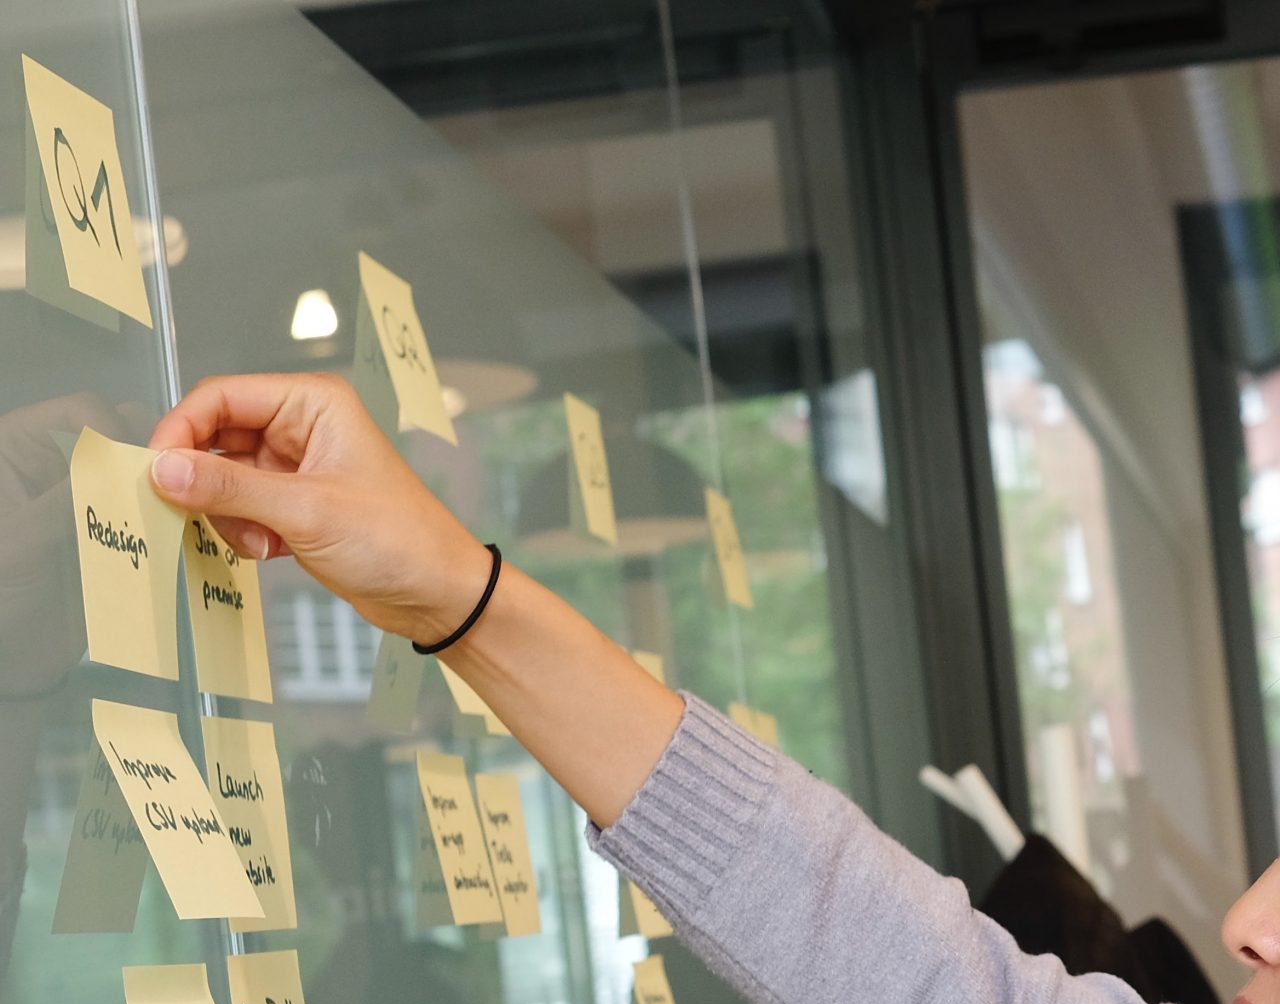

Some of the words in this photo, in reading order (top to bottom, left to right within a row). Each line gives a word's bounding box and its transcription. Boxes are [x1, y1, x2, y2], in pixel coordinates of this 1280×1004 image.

[54, 127, 123, 260] Q1
[86, 504, 148, 570] Redesign
[202, 579, 244, 611] premise
[108, 741, 178, 791] Improve
[216, 761, 265, 803] Launch
[145, 801, 178, 832] CSV
[180, 807, 226, 845] upload
[228, 825, 252, 848] new
